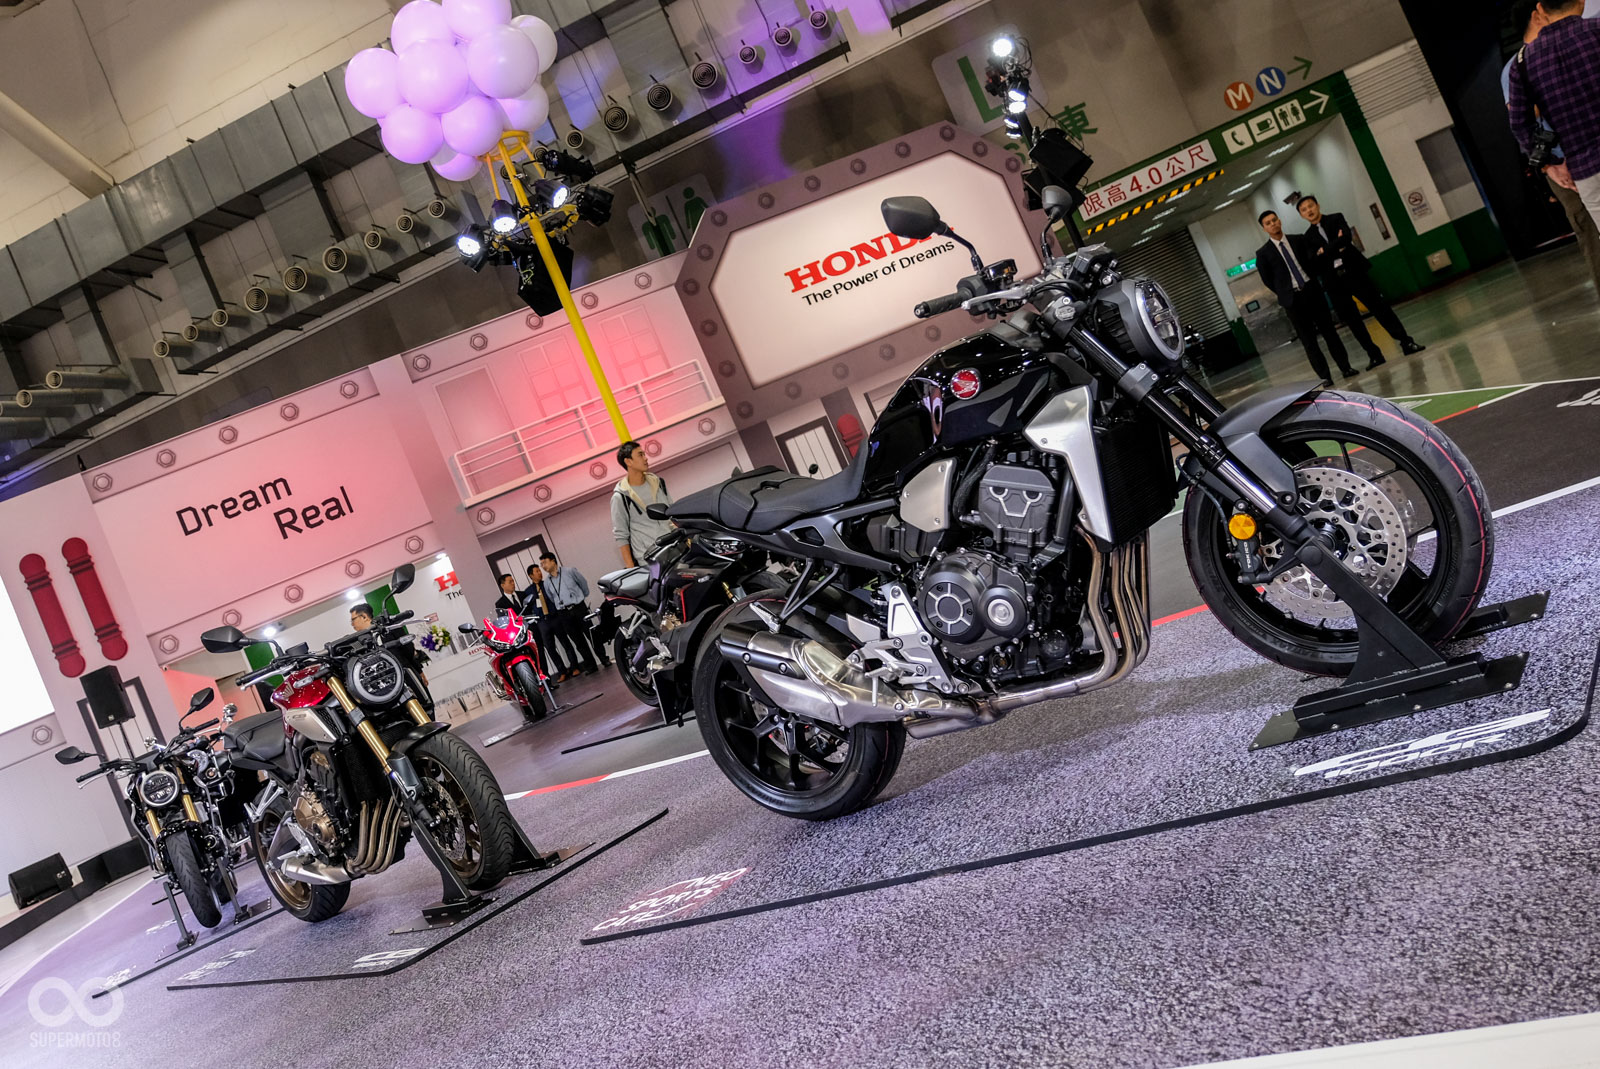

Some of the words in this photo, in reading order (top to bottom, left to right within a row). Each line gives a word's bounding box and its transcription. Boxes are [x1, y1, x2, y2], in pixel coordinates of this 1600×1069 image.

[1226, 83, 1251, 110] M
[1259, 69, 1283, 95] N
[1082, 144, 1210, 217] 限高4.0公尺
[784, 227, 954, 293] HOND
[802, 286, 833, 306] The
[833, 269, 879, 295] Power
[881, 261, 897, 276] of
[899, 241, 955, 269] Dreams
[176, 477, 293, 537] Dream
[273, 485, 354, 540] Real
[1243, 542, 1252, 569] TOKICO
[1325, 733, 1506, 778] 1000R
[620, 885, 722, 914] SPORTS
[685, 868, 747, 889] NEO
